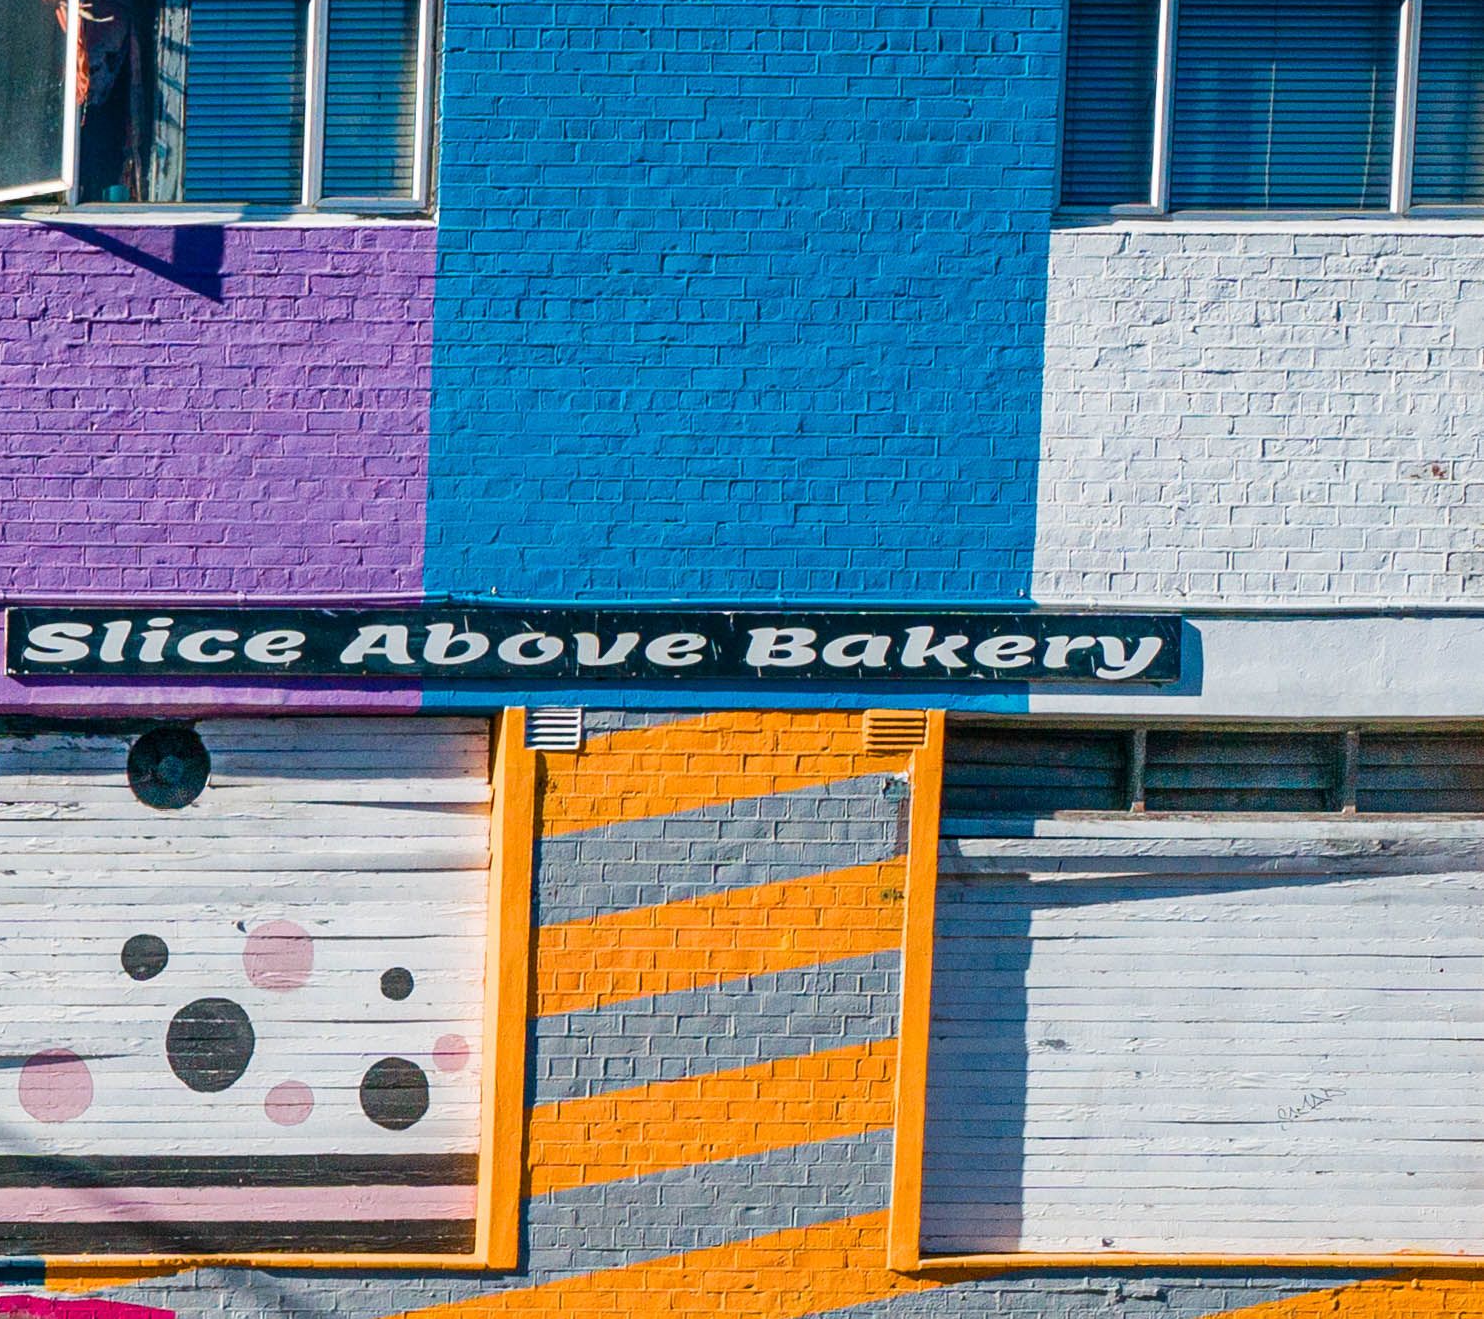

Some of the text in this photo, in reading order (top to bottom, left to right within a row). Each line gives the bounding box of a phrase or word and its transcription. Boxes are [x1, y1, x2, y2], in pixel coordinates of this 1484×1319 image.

[23, 617, 1163, 681] Slice Above Bakery
